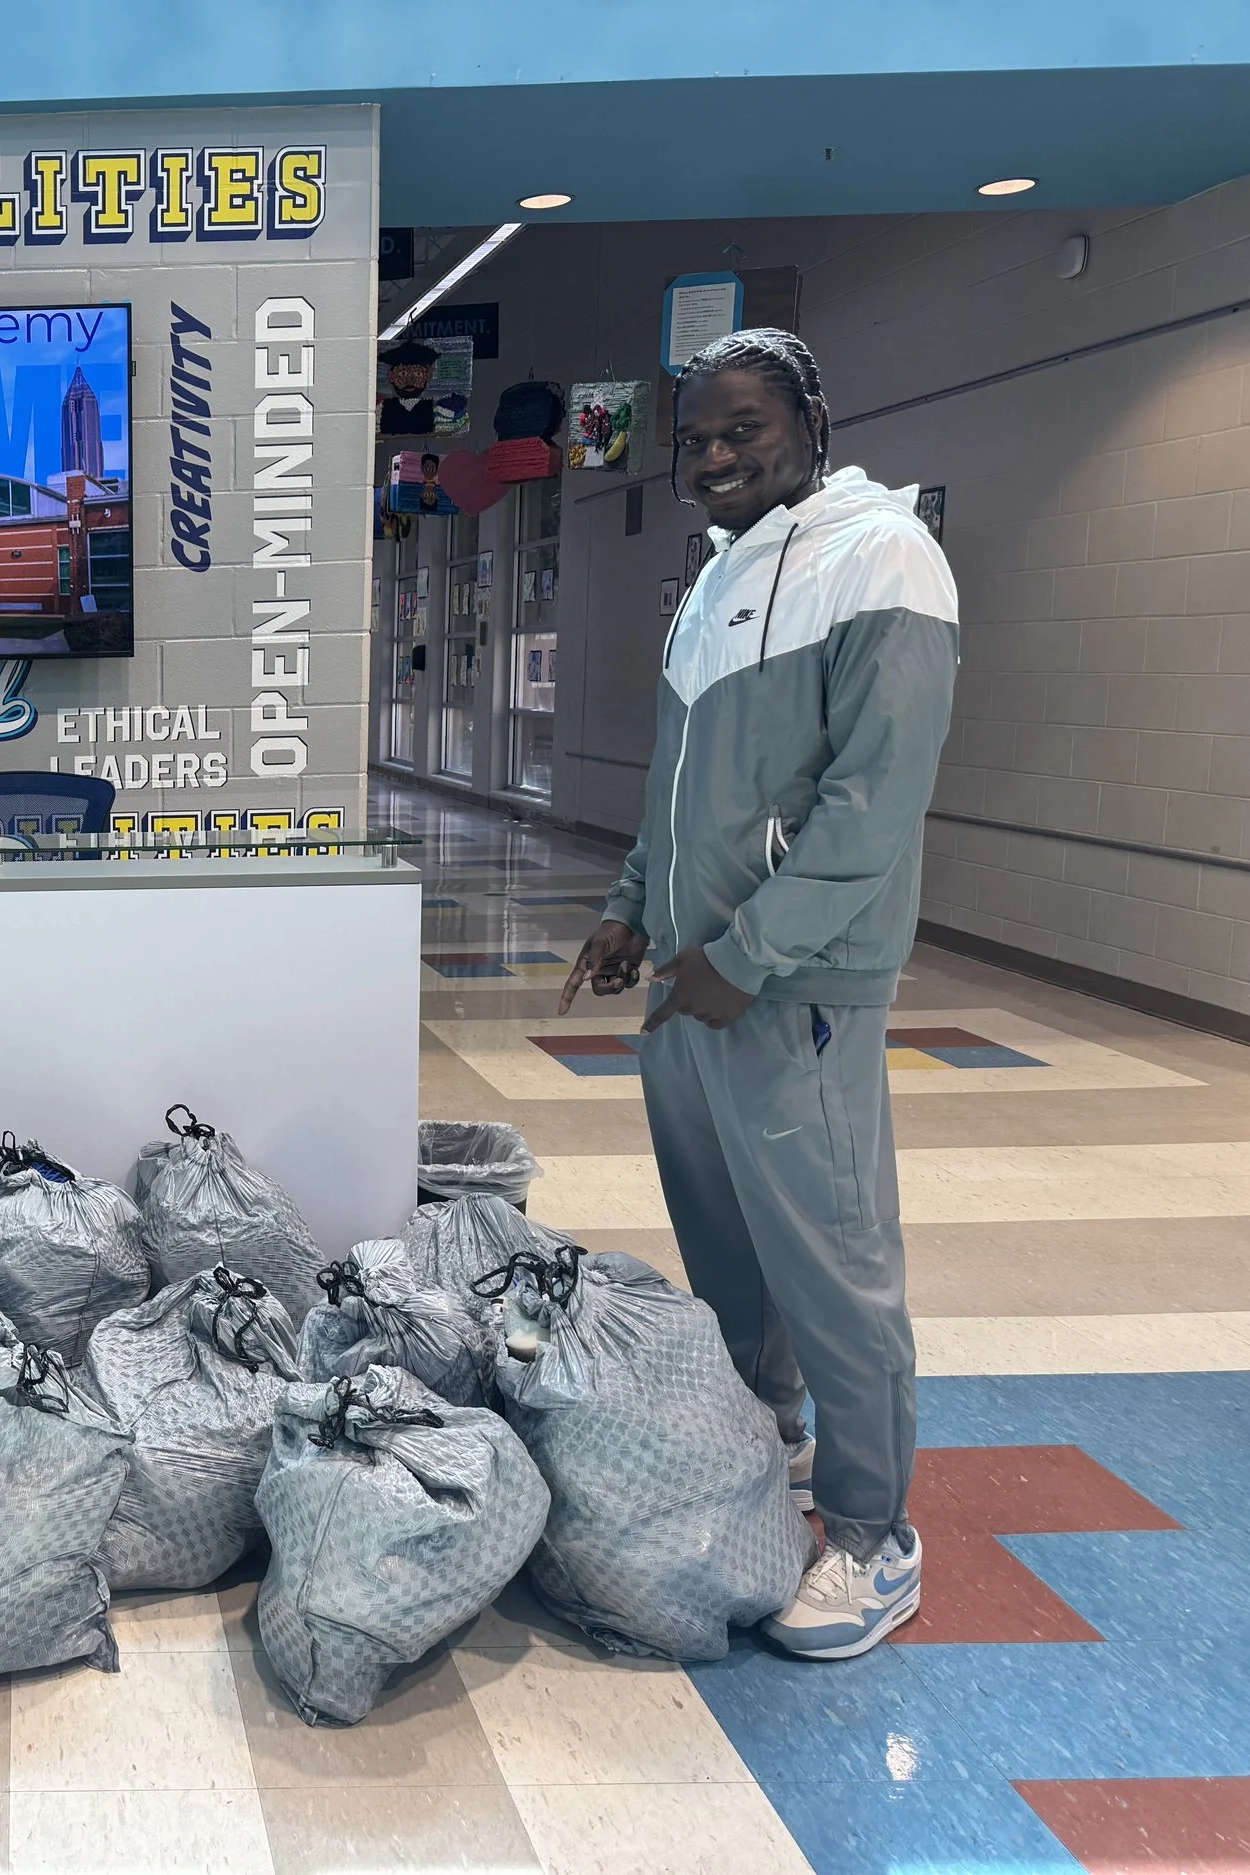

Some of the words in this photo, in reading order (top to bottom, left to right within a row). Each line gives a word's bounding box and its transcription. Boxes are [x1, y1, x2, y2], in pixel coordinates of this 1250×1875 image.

[170, 300, 212, 574] CREATIVITY
[250, 295, 316, 777] OPEN-MINDED
[57, 704, 221, 744] ETHICAL
